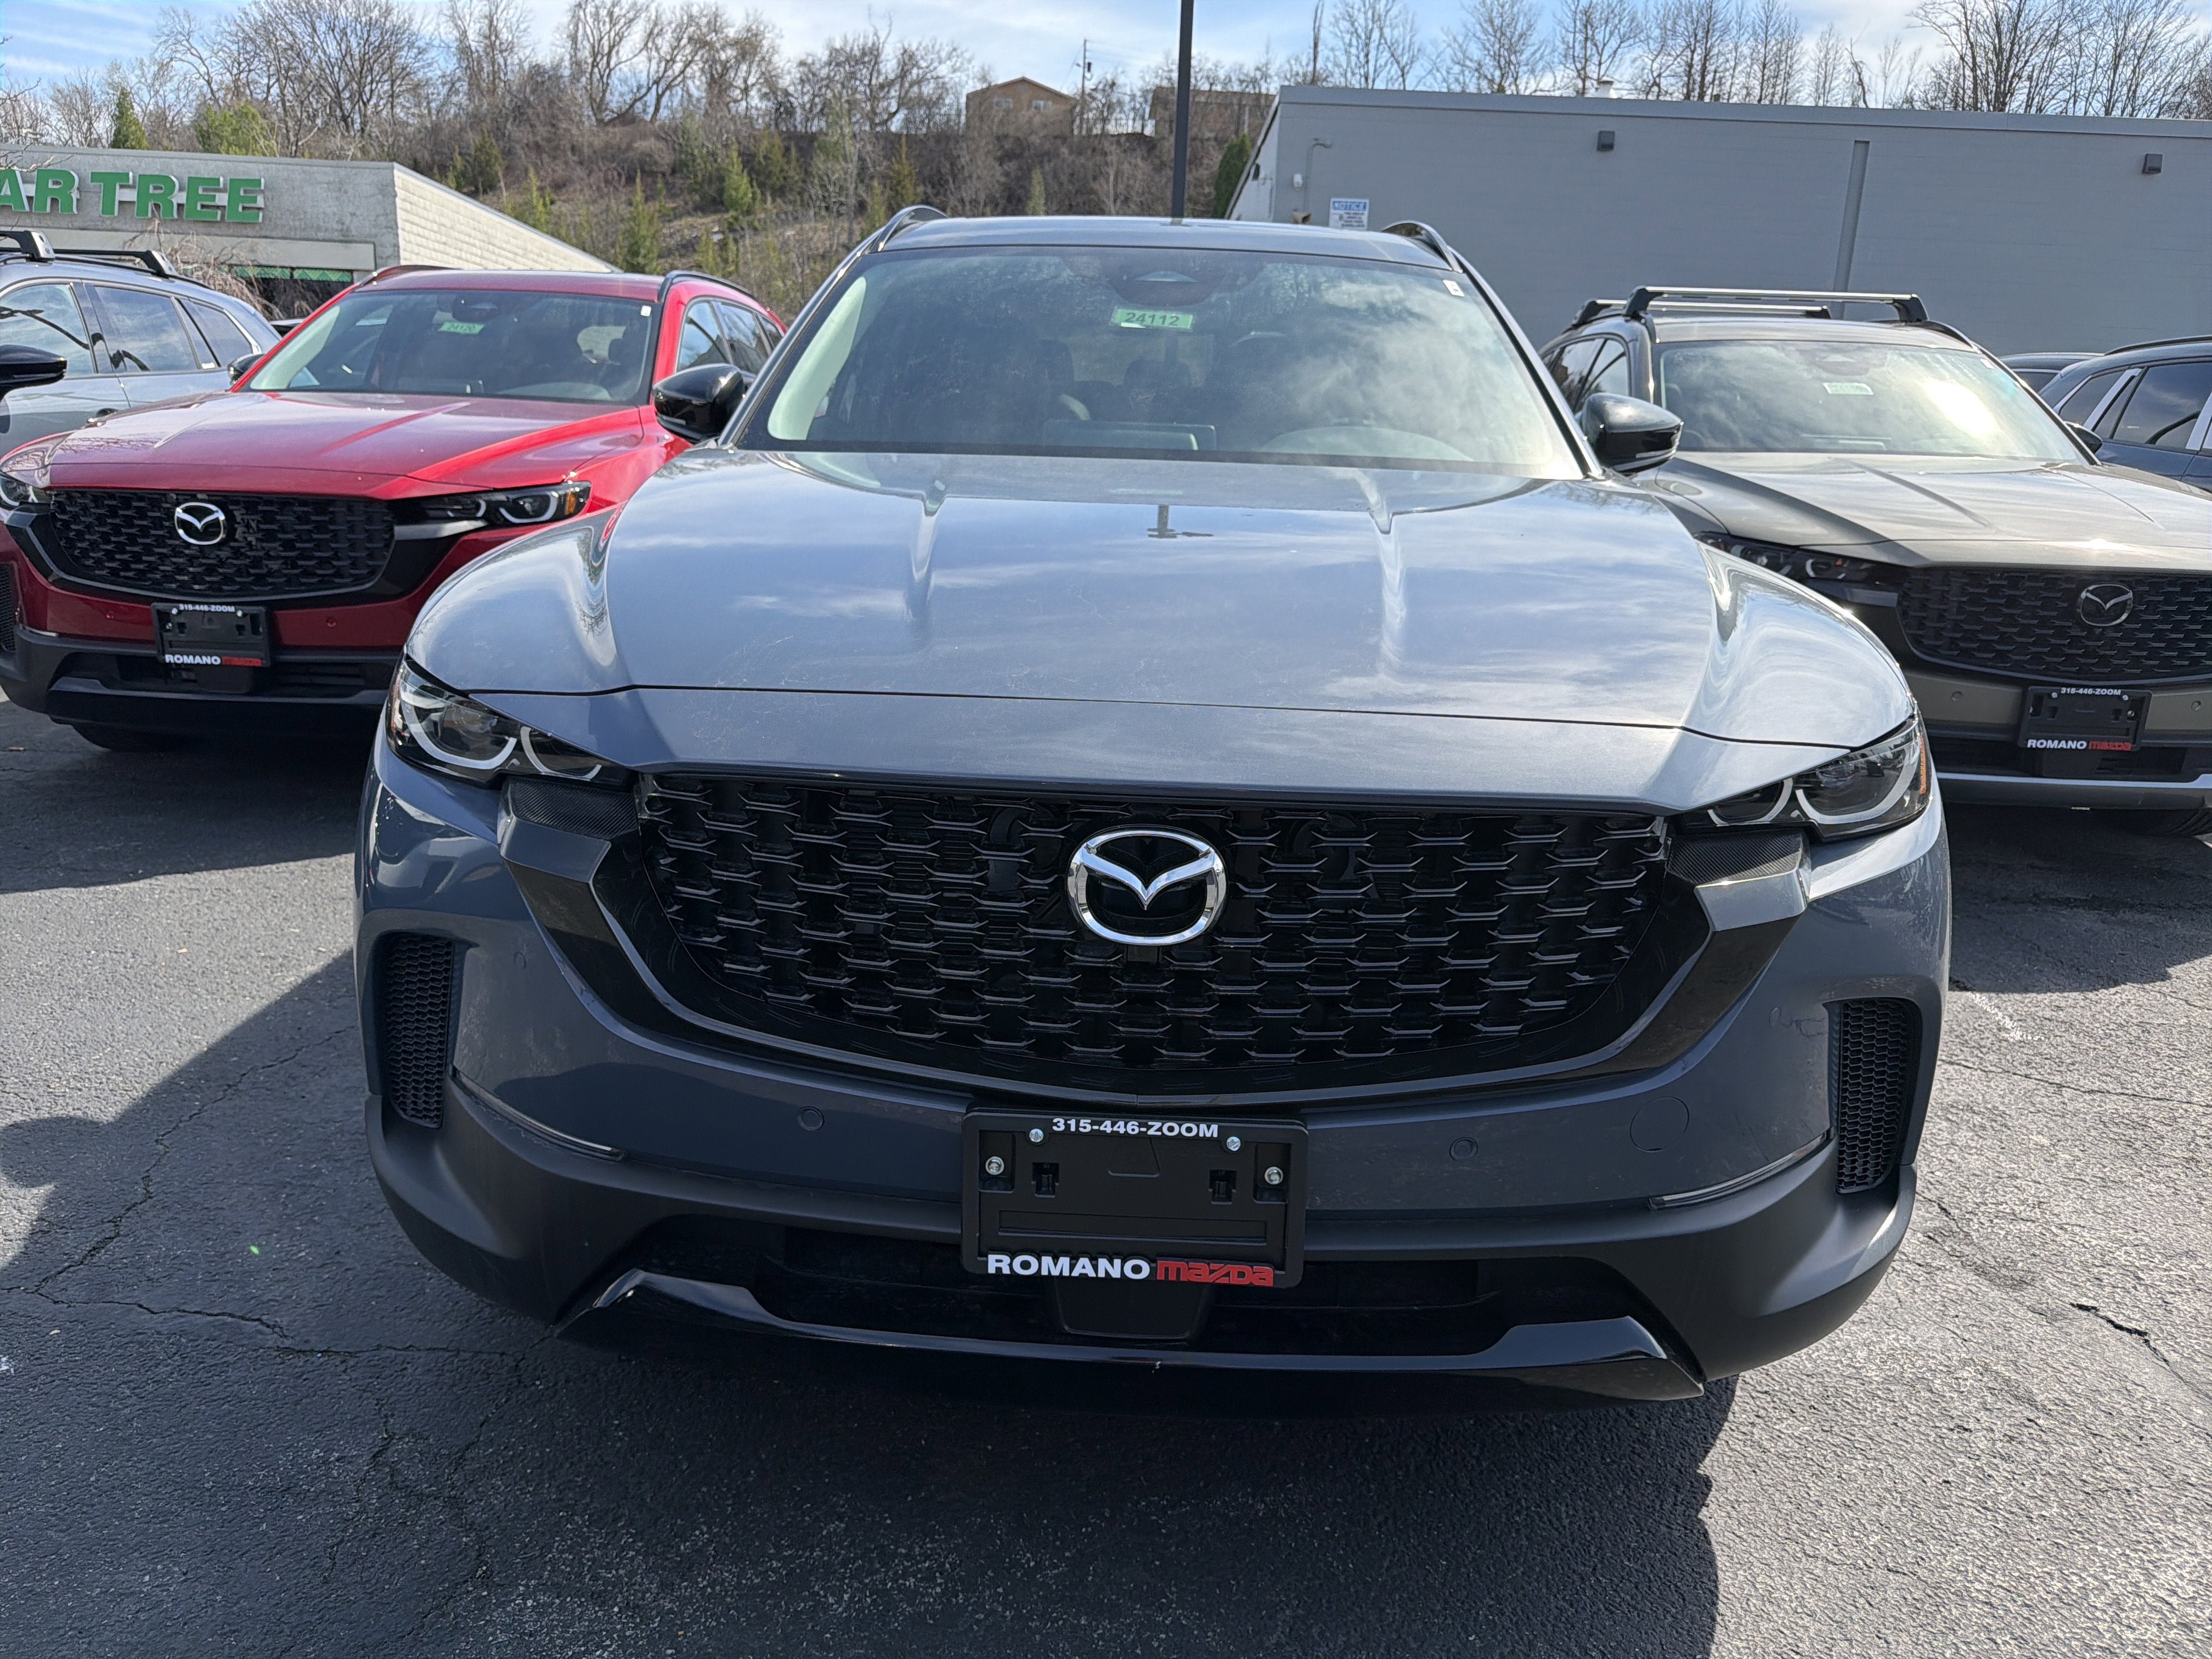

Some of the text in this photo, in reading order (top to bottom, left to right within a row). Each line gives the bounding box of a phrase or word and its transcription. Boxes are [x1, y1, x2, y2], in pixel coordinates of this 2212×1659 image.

[90, 172, 264, 223] TREE
[1125, 312, 1180, 326] 24112
[165, 654, 221, 665] ROMANO
[2027, 739, 2087, 749] ROMANO
[1052, 1118, 1218, 1138] 315-446-ZOOM
[988, 1254, 1150, 1280] ROMANO
